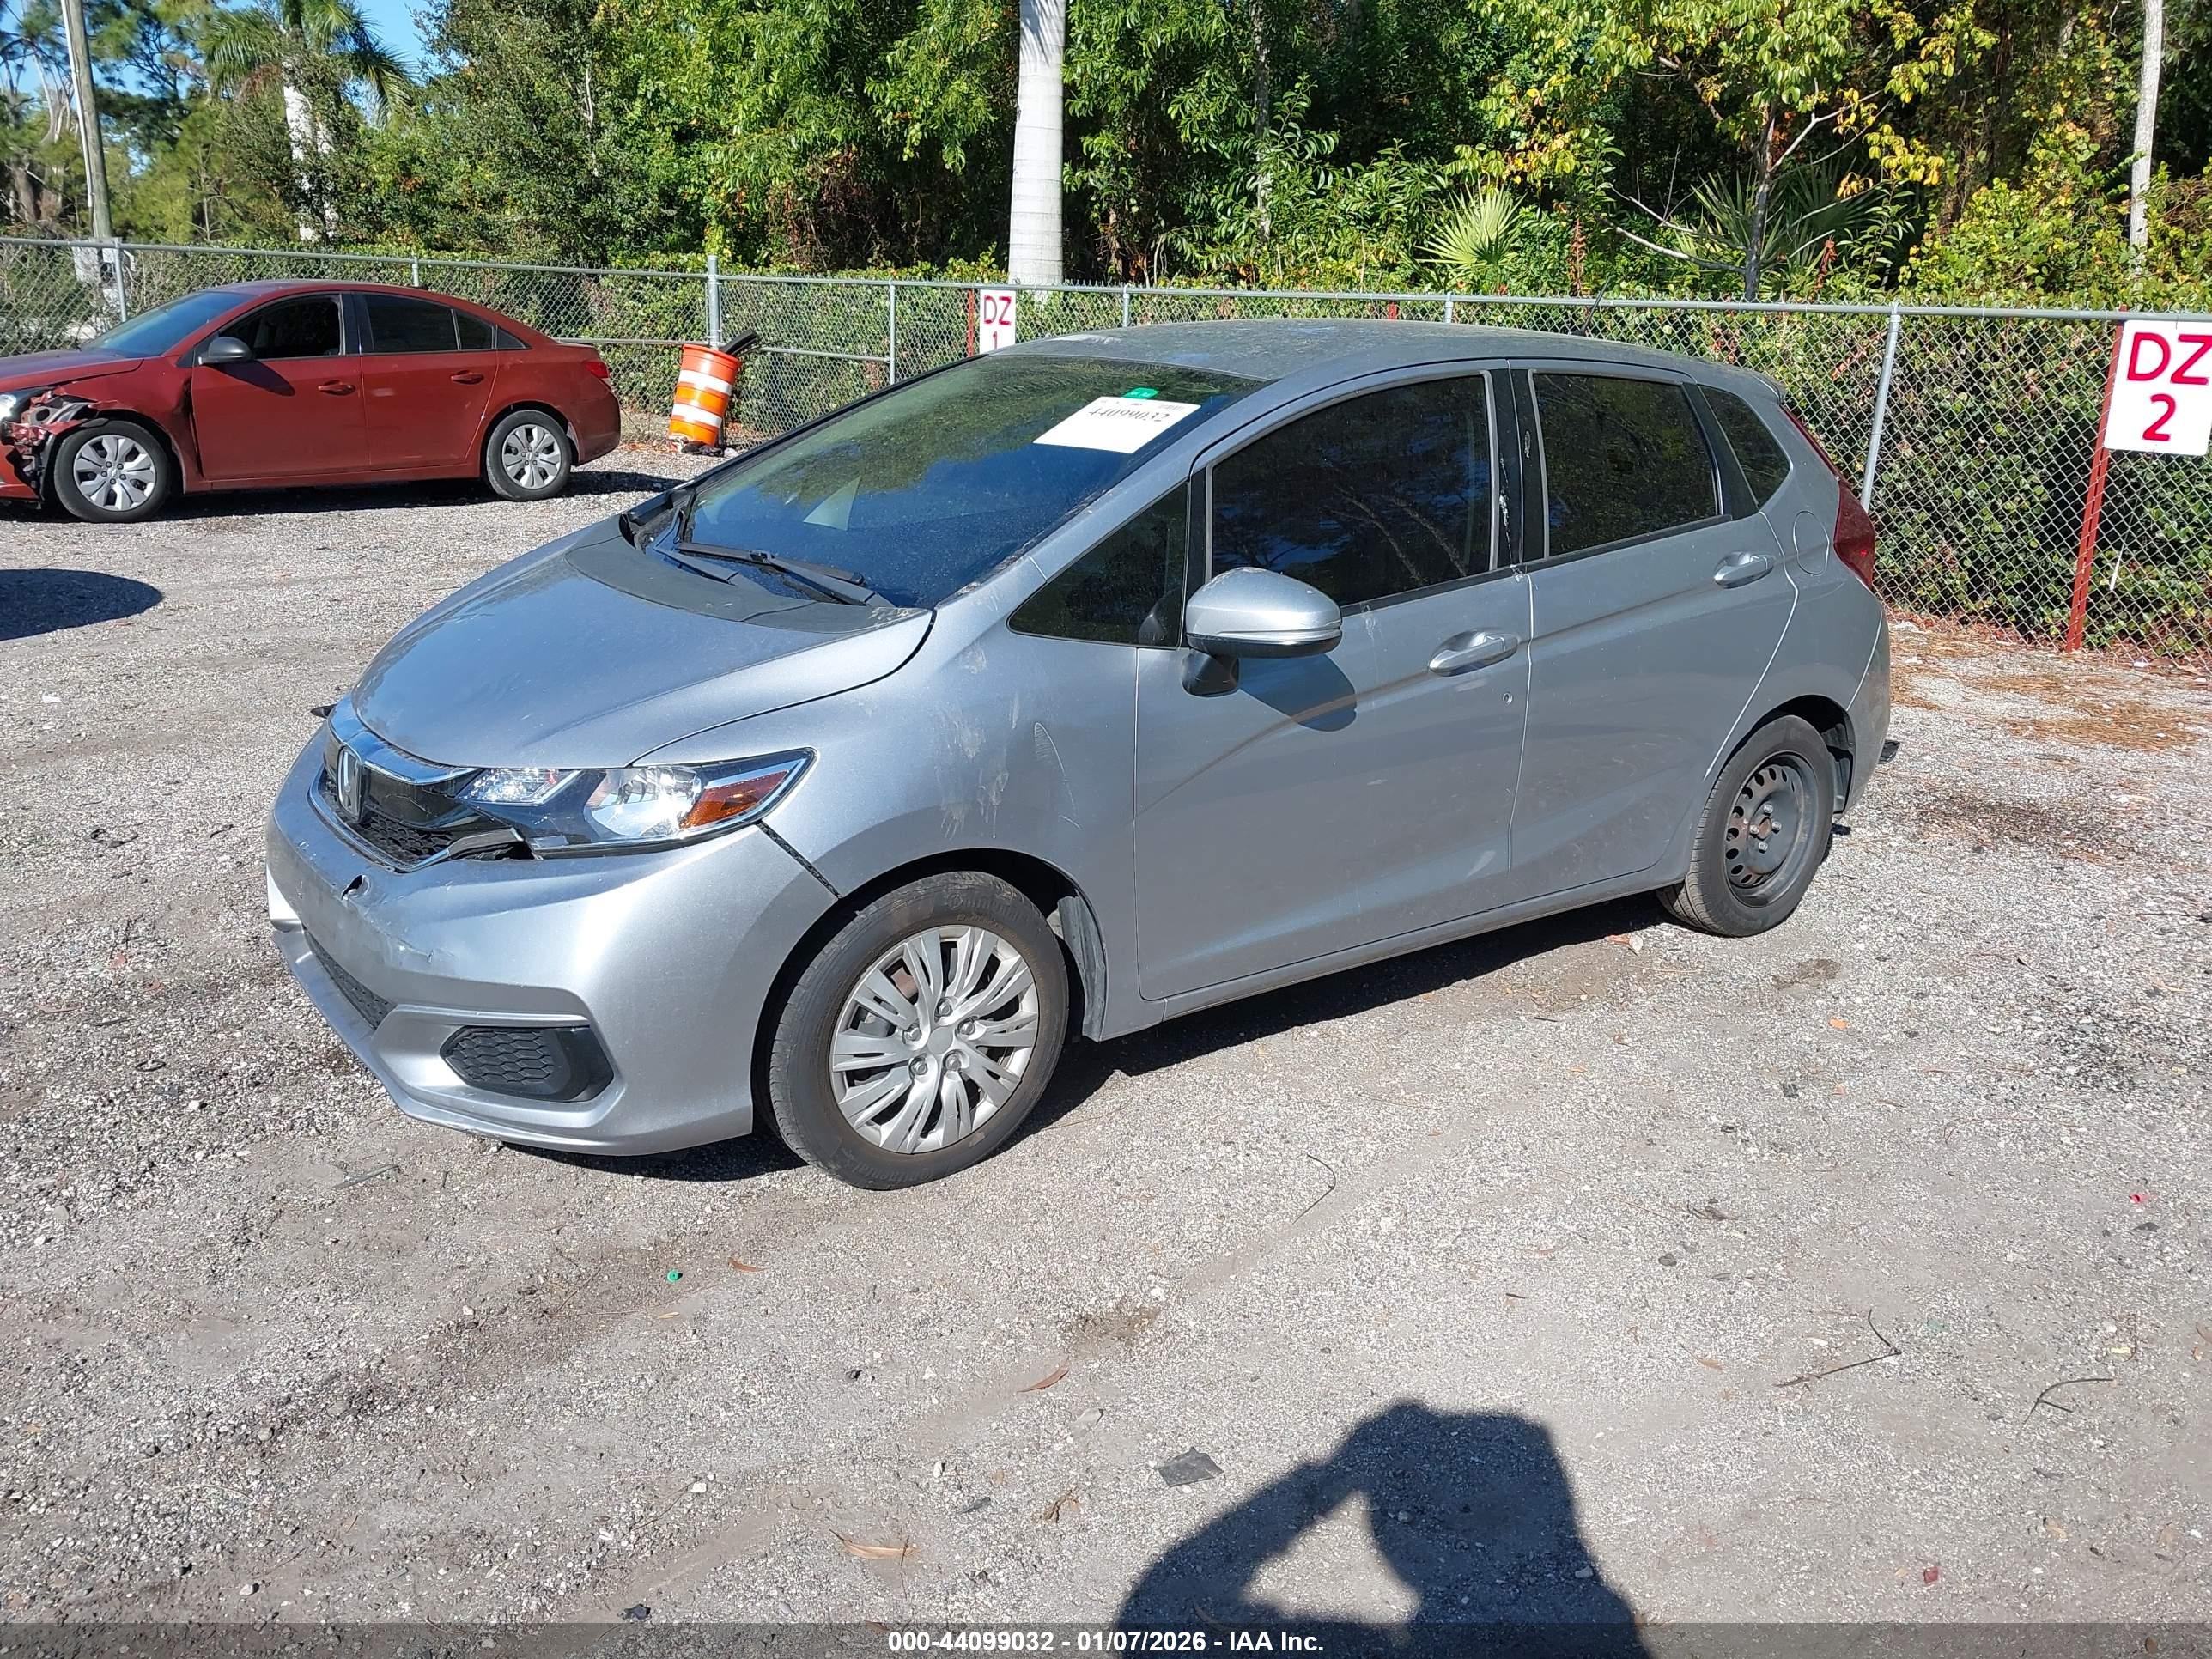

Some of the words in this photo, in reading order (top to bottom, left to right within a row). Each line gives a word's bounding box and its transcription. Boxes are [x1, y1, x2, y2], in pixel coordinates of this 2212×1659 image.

[984, 295, 1012, 325] DZ
[993, 331, 998, 351] 1
[2127, 331, 2212, 386] DZ
[2142, 393, 2177, 441] 2
